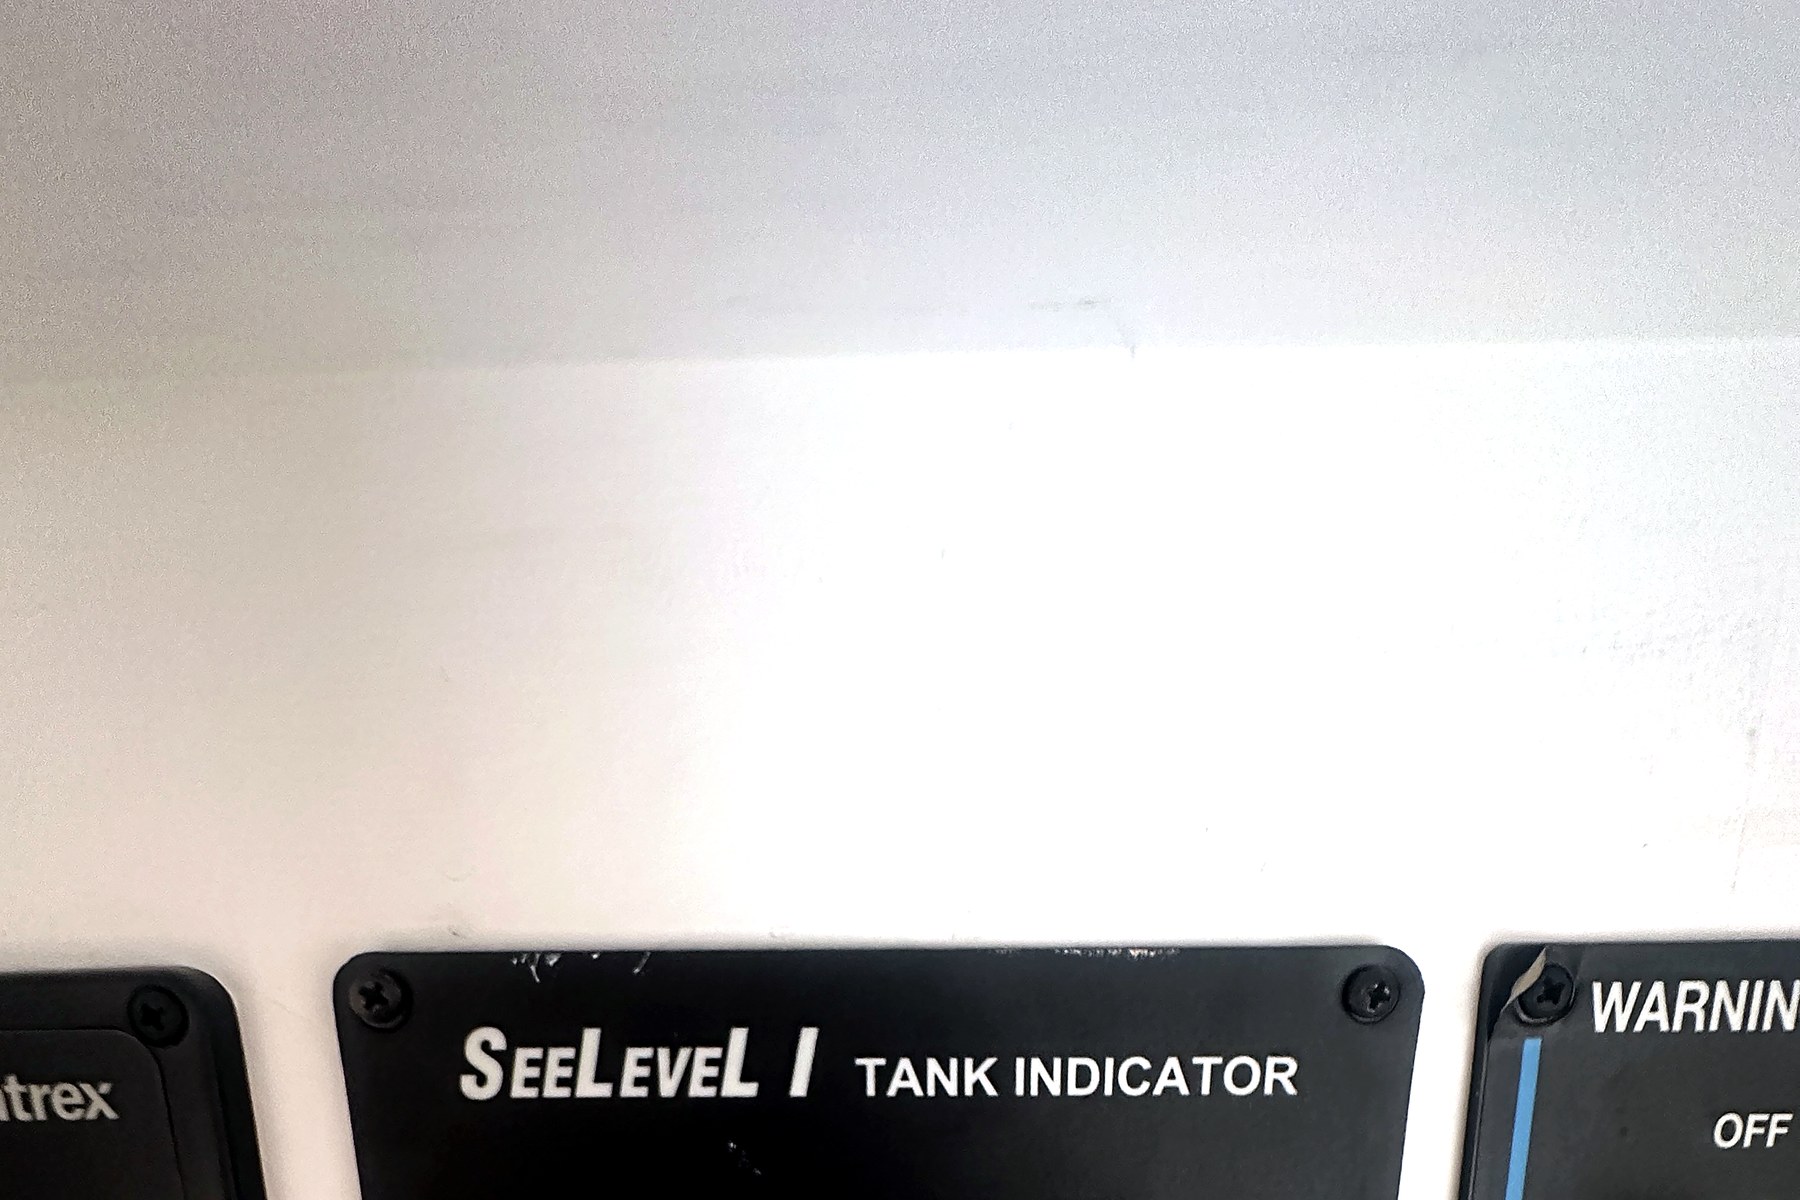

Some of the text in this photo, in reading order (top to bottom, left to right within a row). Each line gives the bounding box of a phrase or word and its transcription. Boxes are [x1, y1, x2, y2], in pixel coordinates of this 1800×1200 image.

[1592, 979, 1800, 1033] WARNIN
[789, 1027, 819, 1098] I
[854, 1057, 999, 1097] TANK
[1014, 1055, 1298, 1097] INDICATOR
[1713, 1112, 1794, 1149] OFF
